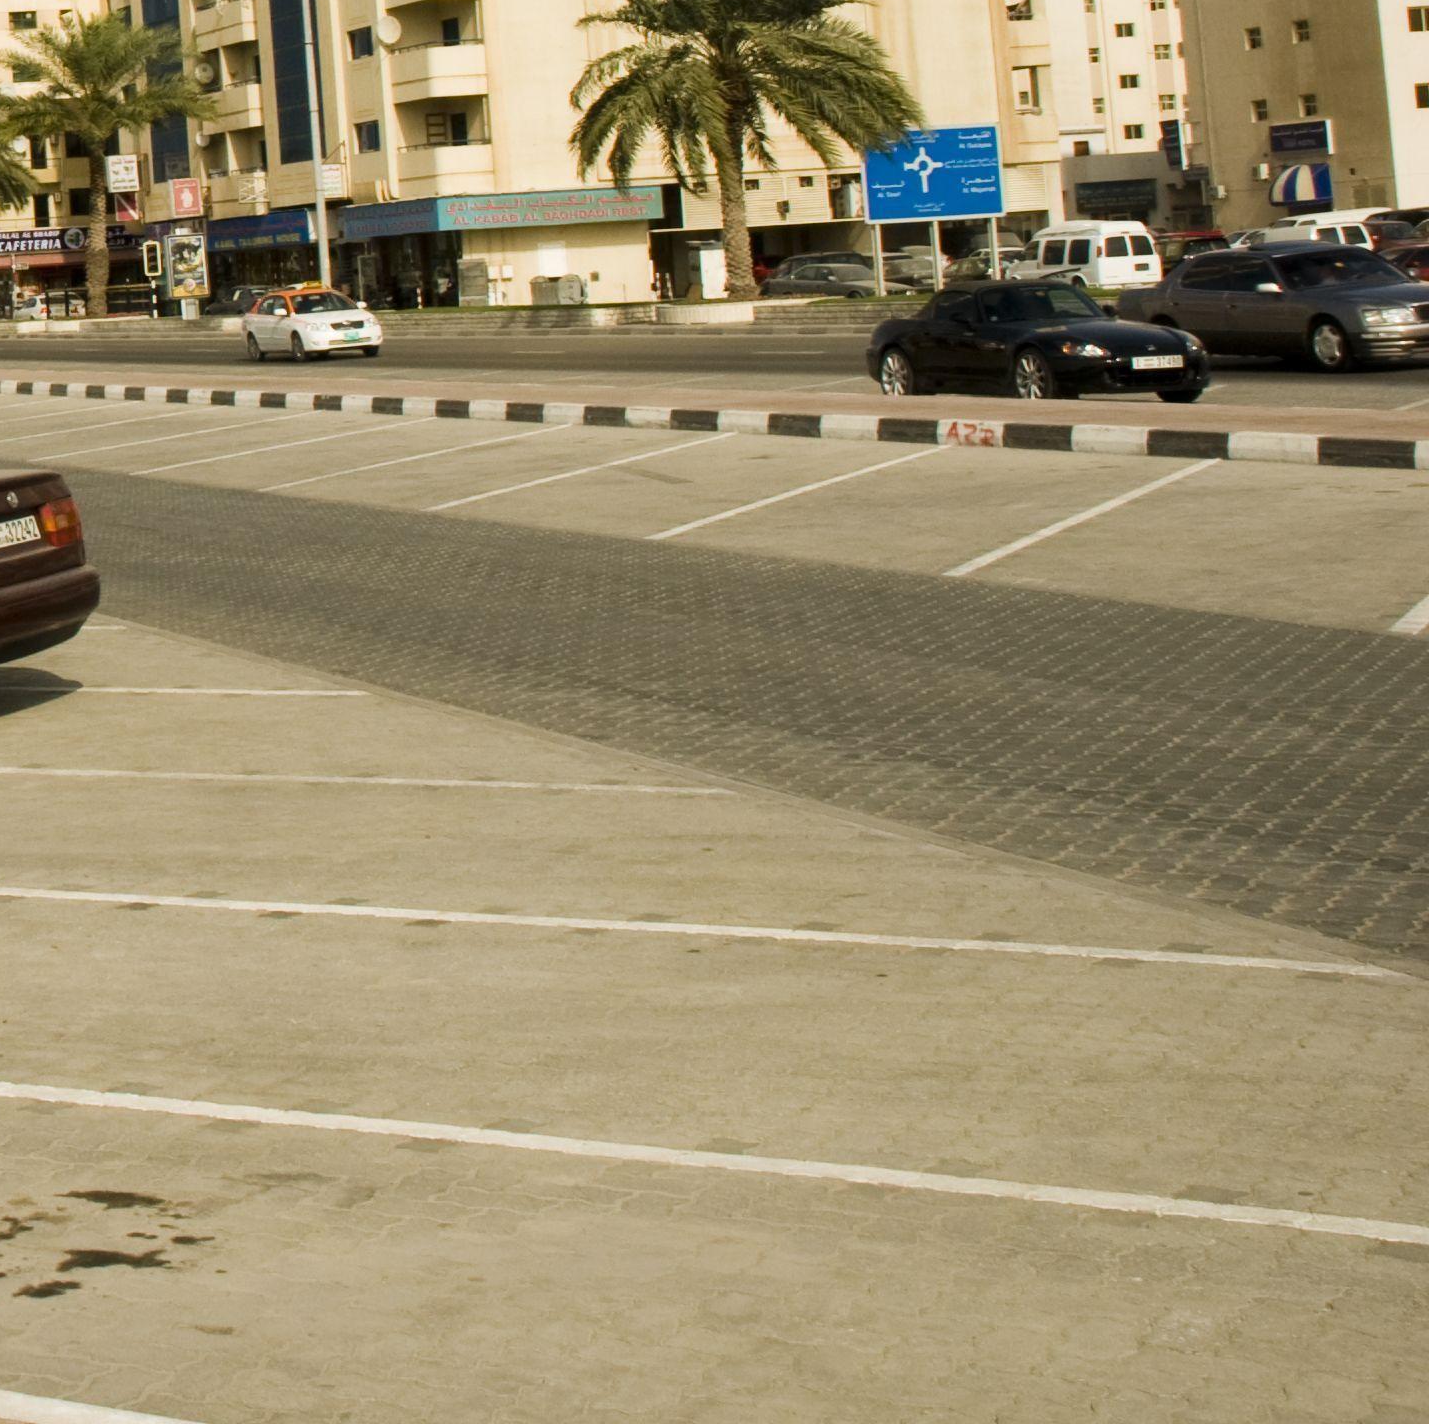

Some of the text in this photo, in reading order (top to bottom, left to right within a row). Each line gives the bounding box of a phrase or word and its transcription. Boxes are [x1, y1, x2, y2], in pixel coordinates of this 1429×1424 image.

[454, 215, 470, 226] AL
[474, 213, 519, 225] KABAB
[523, 211, 539, 222] AL
[544, 208, 610, 221] BAGHDADI
[5, 518, 38, 543] 32242
